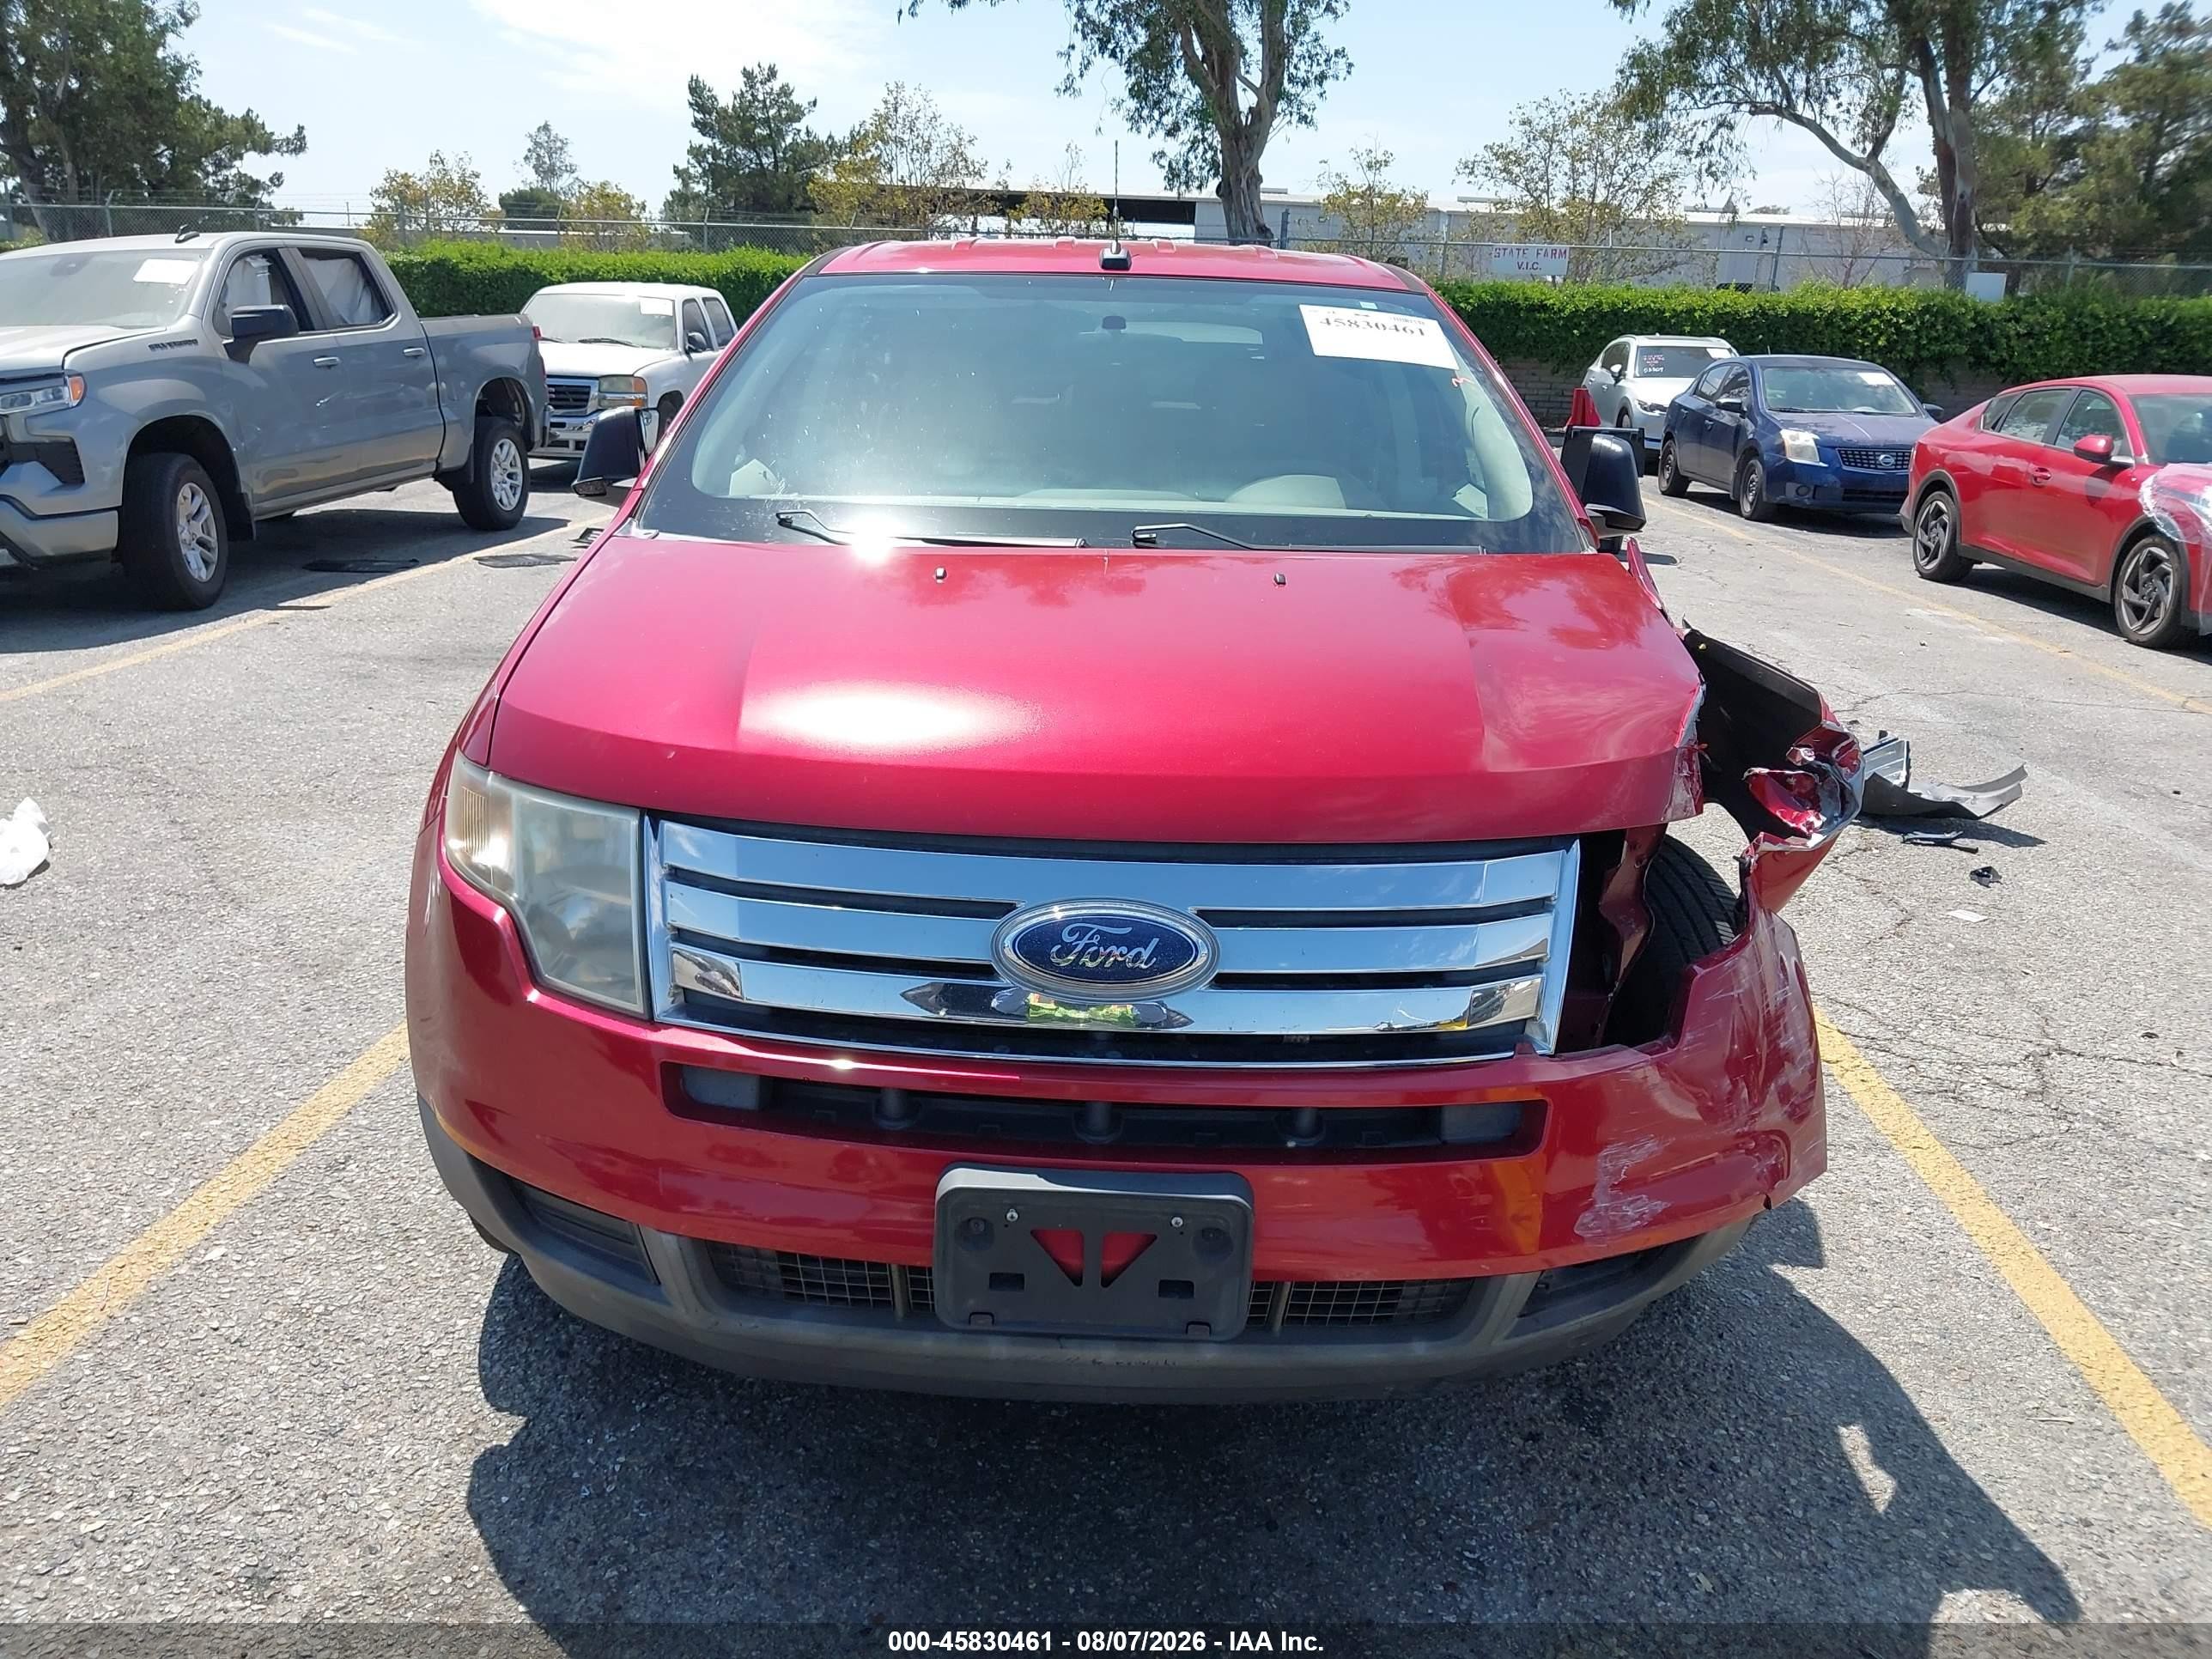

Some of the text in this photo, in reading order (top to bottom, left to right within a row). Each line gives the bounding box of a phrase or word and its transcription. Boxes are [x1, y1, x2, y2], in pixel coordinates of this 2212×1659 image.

[1493, 247, 1567, 260] STATE FARM
[1516, 261, 1542, 270] V.I.C.
[1320, 317, 1425, 337] 45830461
[1049, 922, 1160, 969] Ford
